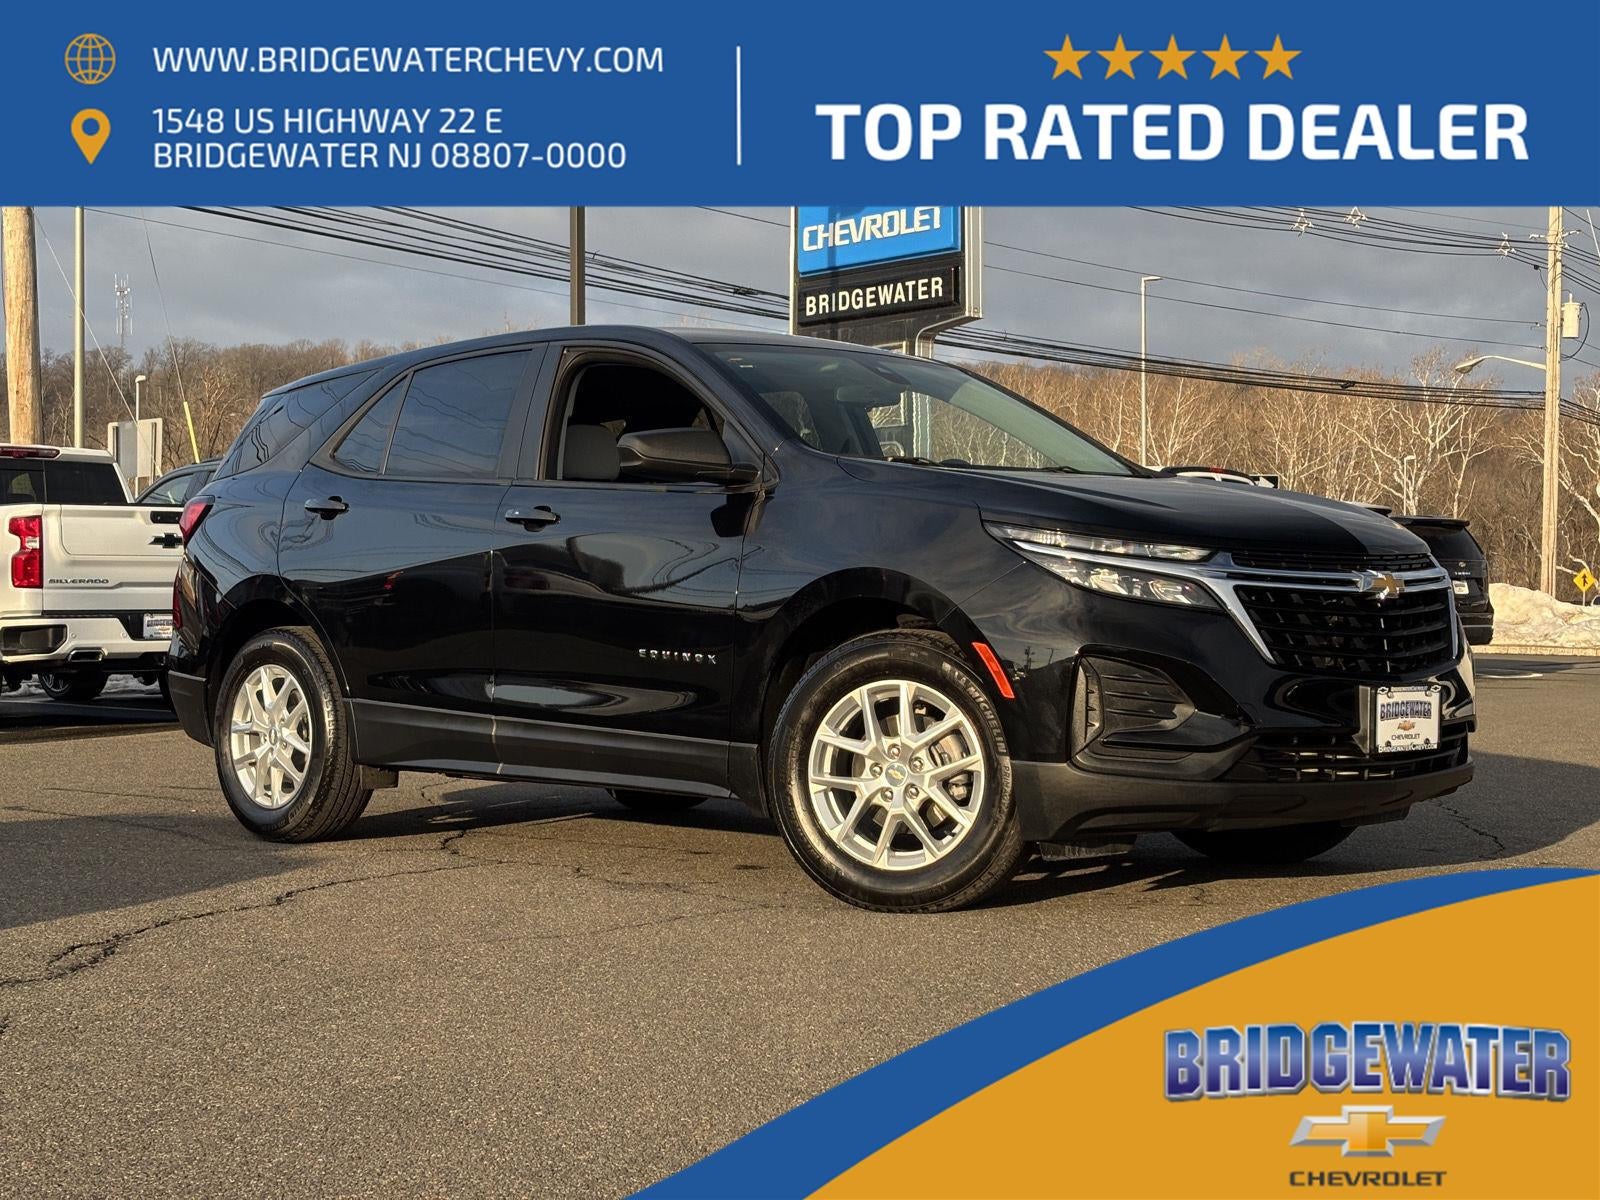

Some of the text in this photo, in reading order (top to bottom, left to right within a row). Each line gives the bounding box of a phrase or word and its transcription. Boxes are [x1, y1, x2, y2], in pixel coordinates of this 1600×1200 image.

[802, 206, 942, 252] CHEVROLET
[805, 276, 943, 317] BRIDGEWATER
[638, 648, 718, 665] EQUINOX
[967, 687, 1007, 753] MICHELIN
[1380, 700, 1432, 721] BRIDGEWATER
[1391, 733, 1421, 741] CHEVROLET
